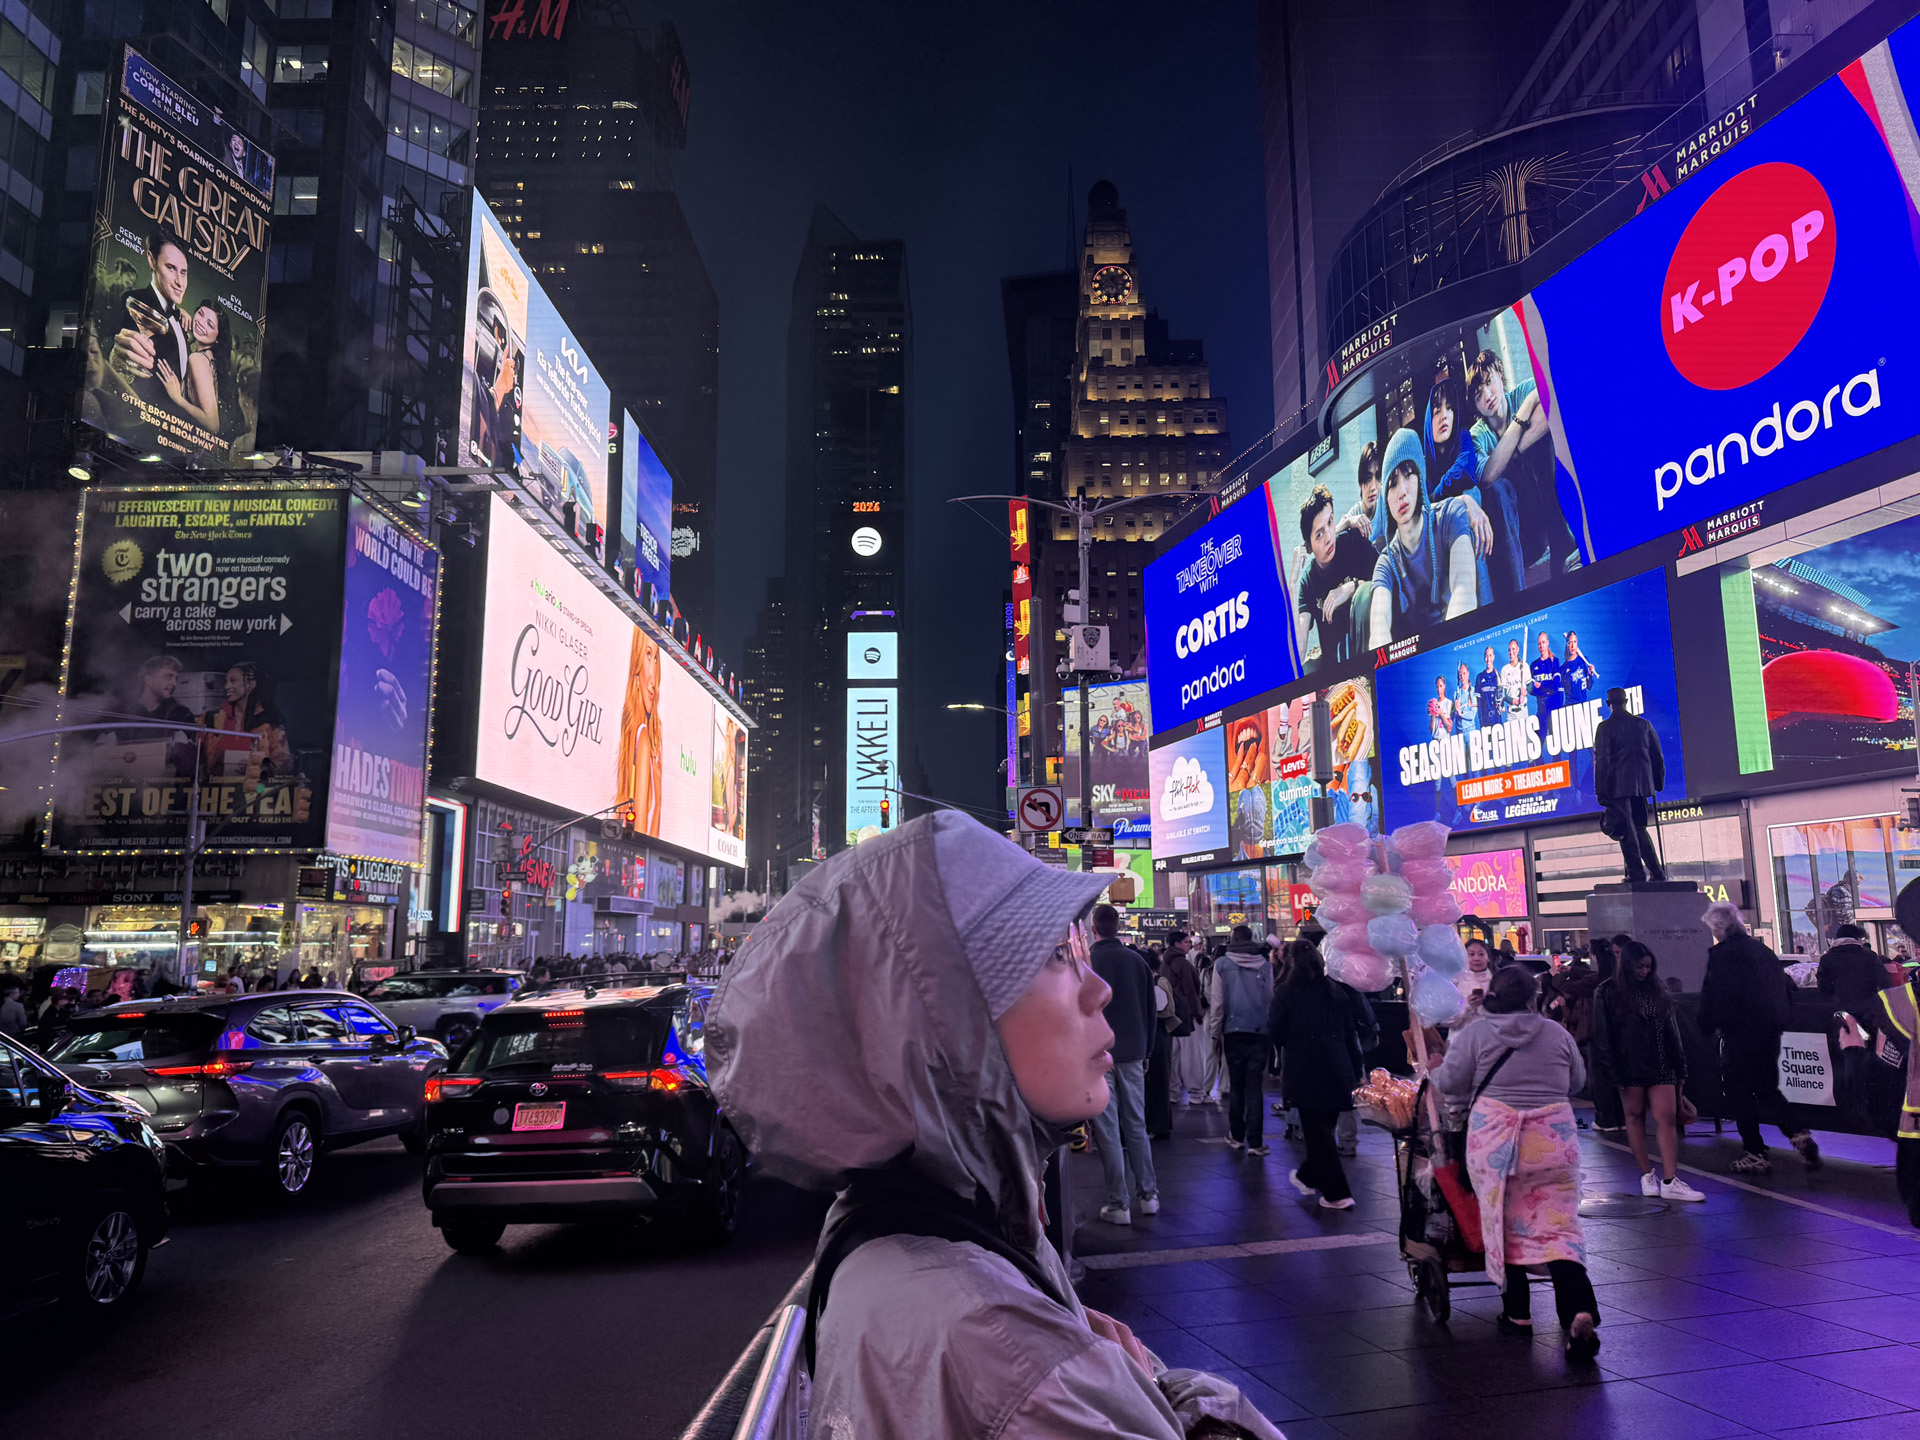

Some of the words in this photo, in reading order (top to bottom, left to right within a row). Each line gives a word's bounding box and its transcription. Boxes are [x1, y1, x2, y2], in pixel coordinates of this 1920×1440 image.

[489, 0, 569, 41] H&M
[133, 71, 172, 106] CORBIN
[175, 103, 199, 126] BLEU
[140, 67, 159, 85] NOW
[161, 83, 197, 114] STARRING
[152, 98, 161, 108] AS
[163, 105, 182, 124] NICK
[1676, 94, 1757, 163] MARRIOTT
[119, 97, 137, 117] THE
[139, 112, 175, 144] PARTY'S
[177, 140, 215, 173] ROARING
[216, 169, 229, 183] ON
[230, 179, 271, 214] BROADWAY
[121, 122, 172, 188] THE
[1678, 120, 1749, 179] MARQUIS
[178, 167, 270, 252] GREAT
[119, 226, 142, 246] REEVE
[133, 177, 250, 271] GATSBY
[115, 233, 144, 256] CARNEY
[194, 251, 208, 263] NEW
[209, 260, 235, 281] MUSICAL
[1670, 210, 1824, 333] K-POP
[218, 295, 253, 322] NOBLEZADA
[230, 294, 242, 307] EVA
[1341, 314, 1397, 360] MARRIOTT
[1342, 334, 1391, 374] MARQUIS
[129, 395, 146, 411] THE
[148, 402, 193, 432] BROADWAY
[195, 427, 229, 450] THEATRE
[140, 411, 160, 426] 53RD
[162, 423, 168, 431] &
[170, 427, 215, 451] BROADWAY
[1654, 368, 1881, 511] pandora
[1221, 472, 1249, 498] MARRIOTT
[1221, 486, 1246, 509] MARQUIS
[100, 501, 115, 512] AN
[118, 500, 203, 512] EFFERVESCENT
[204, 499, 231, 512] NEW
[233, 499, 283, 511] MUSICAL
[286, 498, 338, 511] COMEDY!
[853, 501, 880, 512] 2026
[1707, 500, 1764, 530] MARRIOTT
[115, 514, 181, 528] LAUGHTER,
[185, 513, 233, 528] ESCAPE,
[1708, 516, 1759, 542] MARQUIS
[174, 531, 189, 539] The
[189, 531, 207, 539] New
[207, 531, 227, 541] York
[228, 530, 252, 539] Times
[368, 513, 386, 542] COME
[387, 526, 399, 551] SEE
[399, 535, 413, 560] HOW
[413, 544, 425, 568] THE
[639, 522, 658, 554] TREVOR
[1200, 537, 1214, 556] THE
[156, 548, 212, 577] two
[237, 555, 263, 564] musical
[264, 556, 290, 565] comedy
[241, 564, 274, 574] broadway
[355, 525, 390, 570] WORLD
[390, 552, 420, 591] COULD
[421, 574, 434, 600] BE
[1176, 534, 1242, 594] TAKEOVER
[141, 576, 287, 608] strangers
[1199, 572, 1218, 594] WITH
[134, 605, 170, 621] carry
[173, 606, 180, 617] a
[185, 603, 216, 618] cake
[166, 618, 211, 631] across
[215, 617, 244, 631] new
[246, 615, 277, 634] york
[1175, 591, 1249, 659] CORTIS
[536, 609, 557, 639] NIKKI
[559, 628, 588, 661] GLASER
[1389, 635, 1420, 652] MARRIOTT
[1454, 640, 1475, 652] ATHLETES
[1476, 630, 1501, 644] UNLIMITED
[1502, 622, 1527, 634] SOFTBALL
[1528, 614, 1548, 625] LEAGUE
[1389, 645, 1417, 660] MARQUIS
[504, 624, 563, 747] GOOD
[562, 665, 603, 757] GIRL
[1181, 658, 1245, 710] pandora
[856, 699, 888, 715] LI
[1345, 719, 1358, 743] me
[1546, 698, 1604, 755] JUNE
[680, 744, 697, 776] hulu
[856, 720, 888, 790] LYKKE
[1399, 735, 1468, 786] SEASON
[1469, 715, 1542, 770] BEGINS
[335, 744, 424, 807] HADESTOWN
[1461, 781, 1483, 800] LEARN
[1483, 777, 1504, 796] MORE
[1513, 766, 1564, 790] THEAUSL.COM
[142, 788, 176, 816] OF
[183, 787, 235, 815] THE
[244, 787, 298, 815] YEA
[334, 792, 372, 810] BROADWAY'S
[372, 801, 393, 815] GLOBAL
[1092, 784, 1115, 802] SKY
[1279, 785, 1312, 802] summer
[850, 806, 860, 814] THE
[1505, 798, 1558, 818] LEGENDARY
[1657, 806, 1703, 821] SEPHORA
[1068, 832, 1084, 840] ONE
[1091, 832, 1107, 840] WAY
[1187, 827, 1193, 836] AT
[717, 838, 738, 857] COACH
[356, 861, 403, 884] LUGGAGE
[112, 893, 154, 902] SONY
[368, 894, 386, 903] SONY
[1142, 918, 1178, 927] KLIKTIX
[1782, 1047, 1820, 1061] Times
[1782, 1061, 1825, 1077] Square
[1785, 1077, 1824, 1090] Alliance
